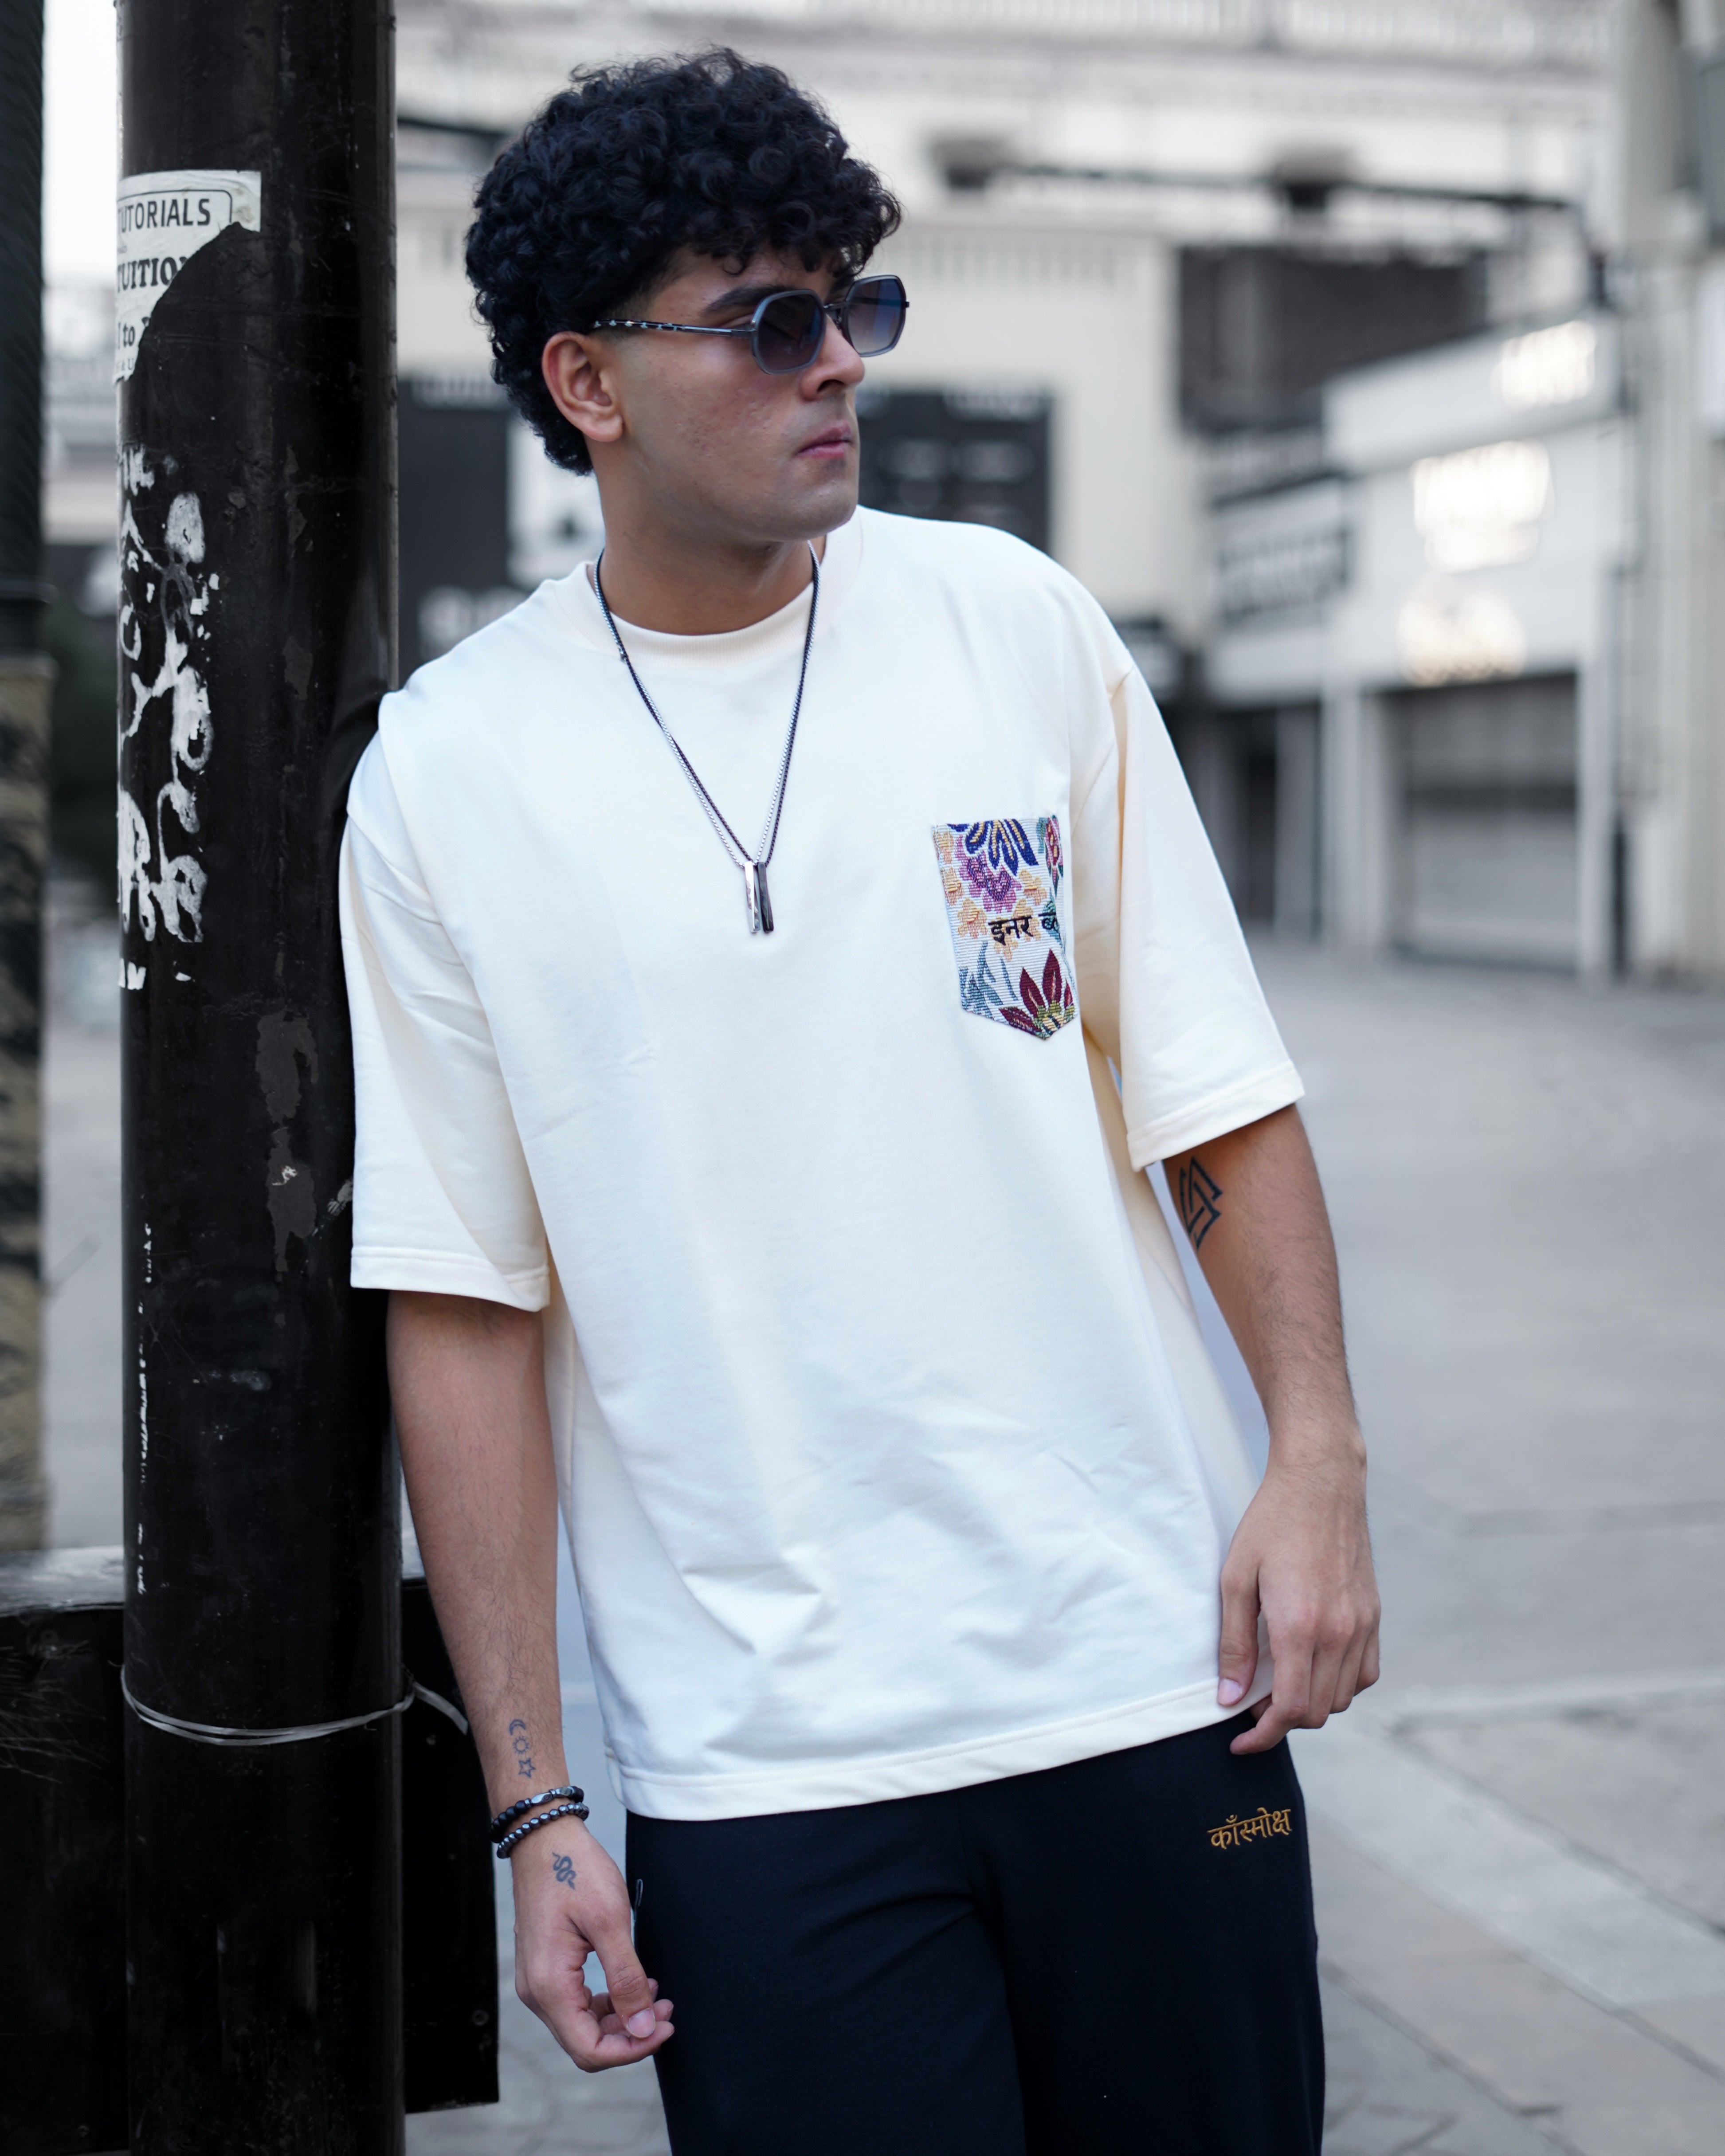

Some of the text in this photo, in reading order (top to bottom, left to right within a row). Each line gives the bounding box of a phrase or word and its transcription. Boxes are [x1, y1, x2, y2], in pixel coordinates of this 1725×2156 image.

[118, 198, 211, 233] TUTORIALS
[118, 256, 188, 293] TUITIO
[988, 915, 1033, 946] इनर
